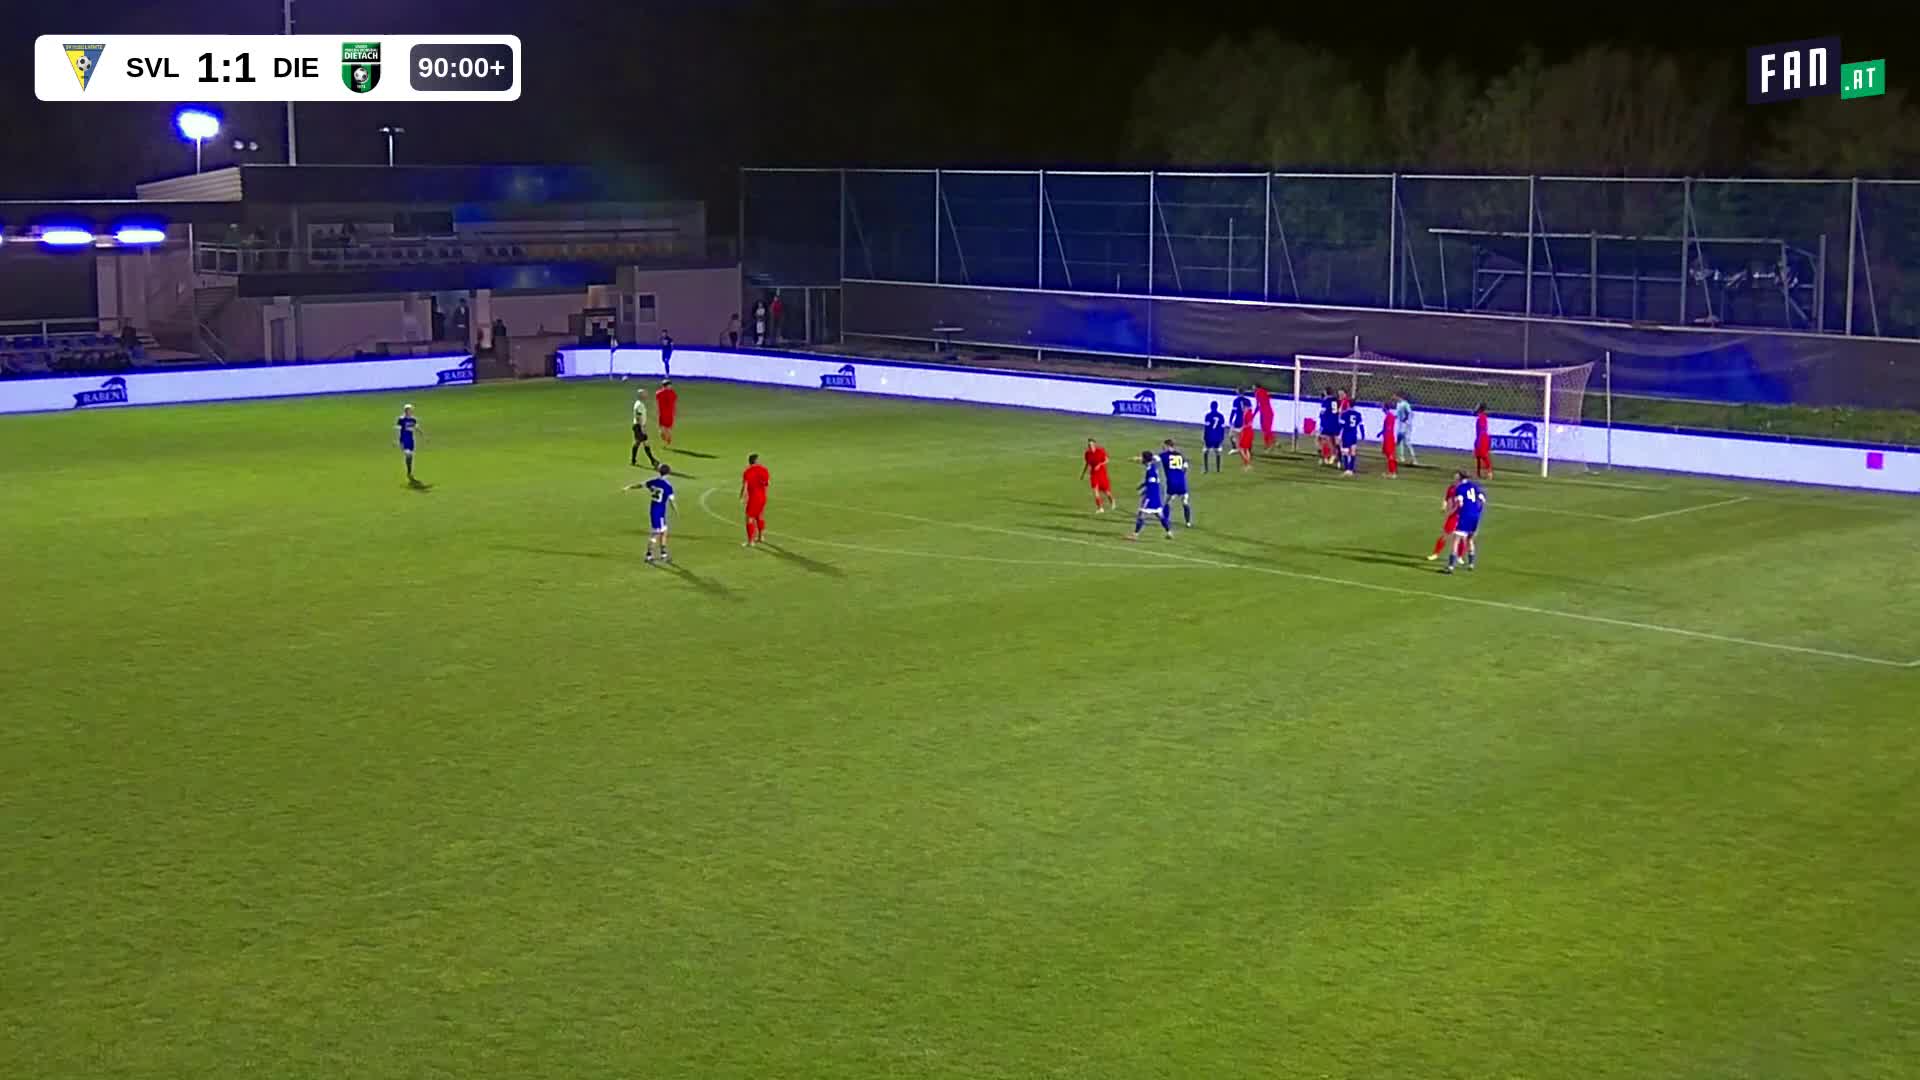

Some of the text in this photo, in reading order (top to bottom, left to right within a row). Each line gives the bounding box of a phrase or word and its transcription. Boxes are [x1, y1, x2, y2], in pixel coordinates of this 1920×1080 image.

[1212, 416, 1220, 430] 7
[1168, 454, 1183, 470] 20
[1466, 487, 1476, 502] 4
